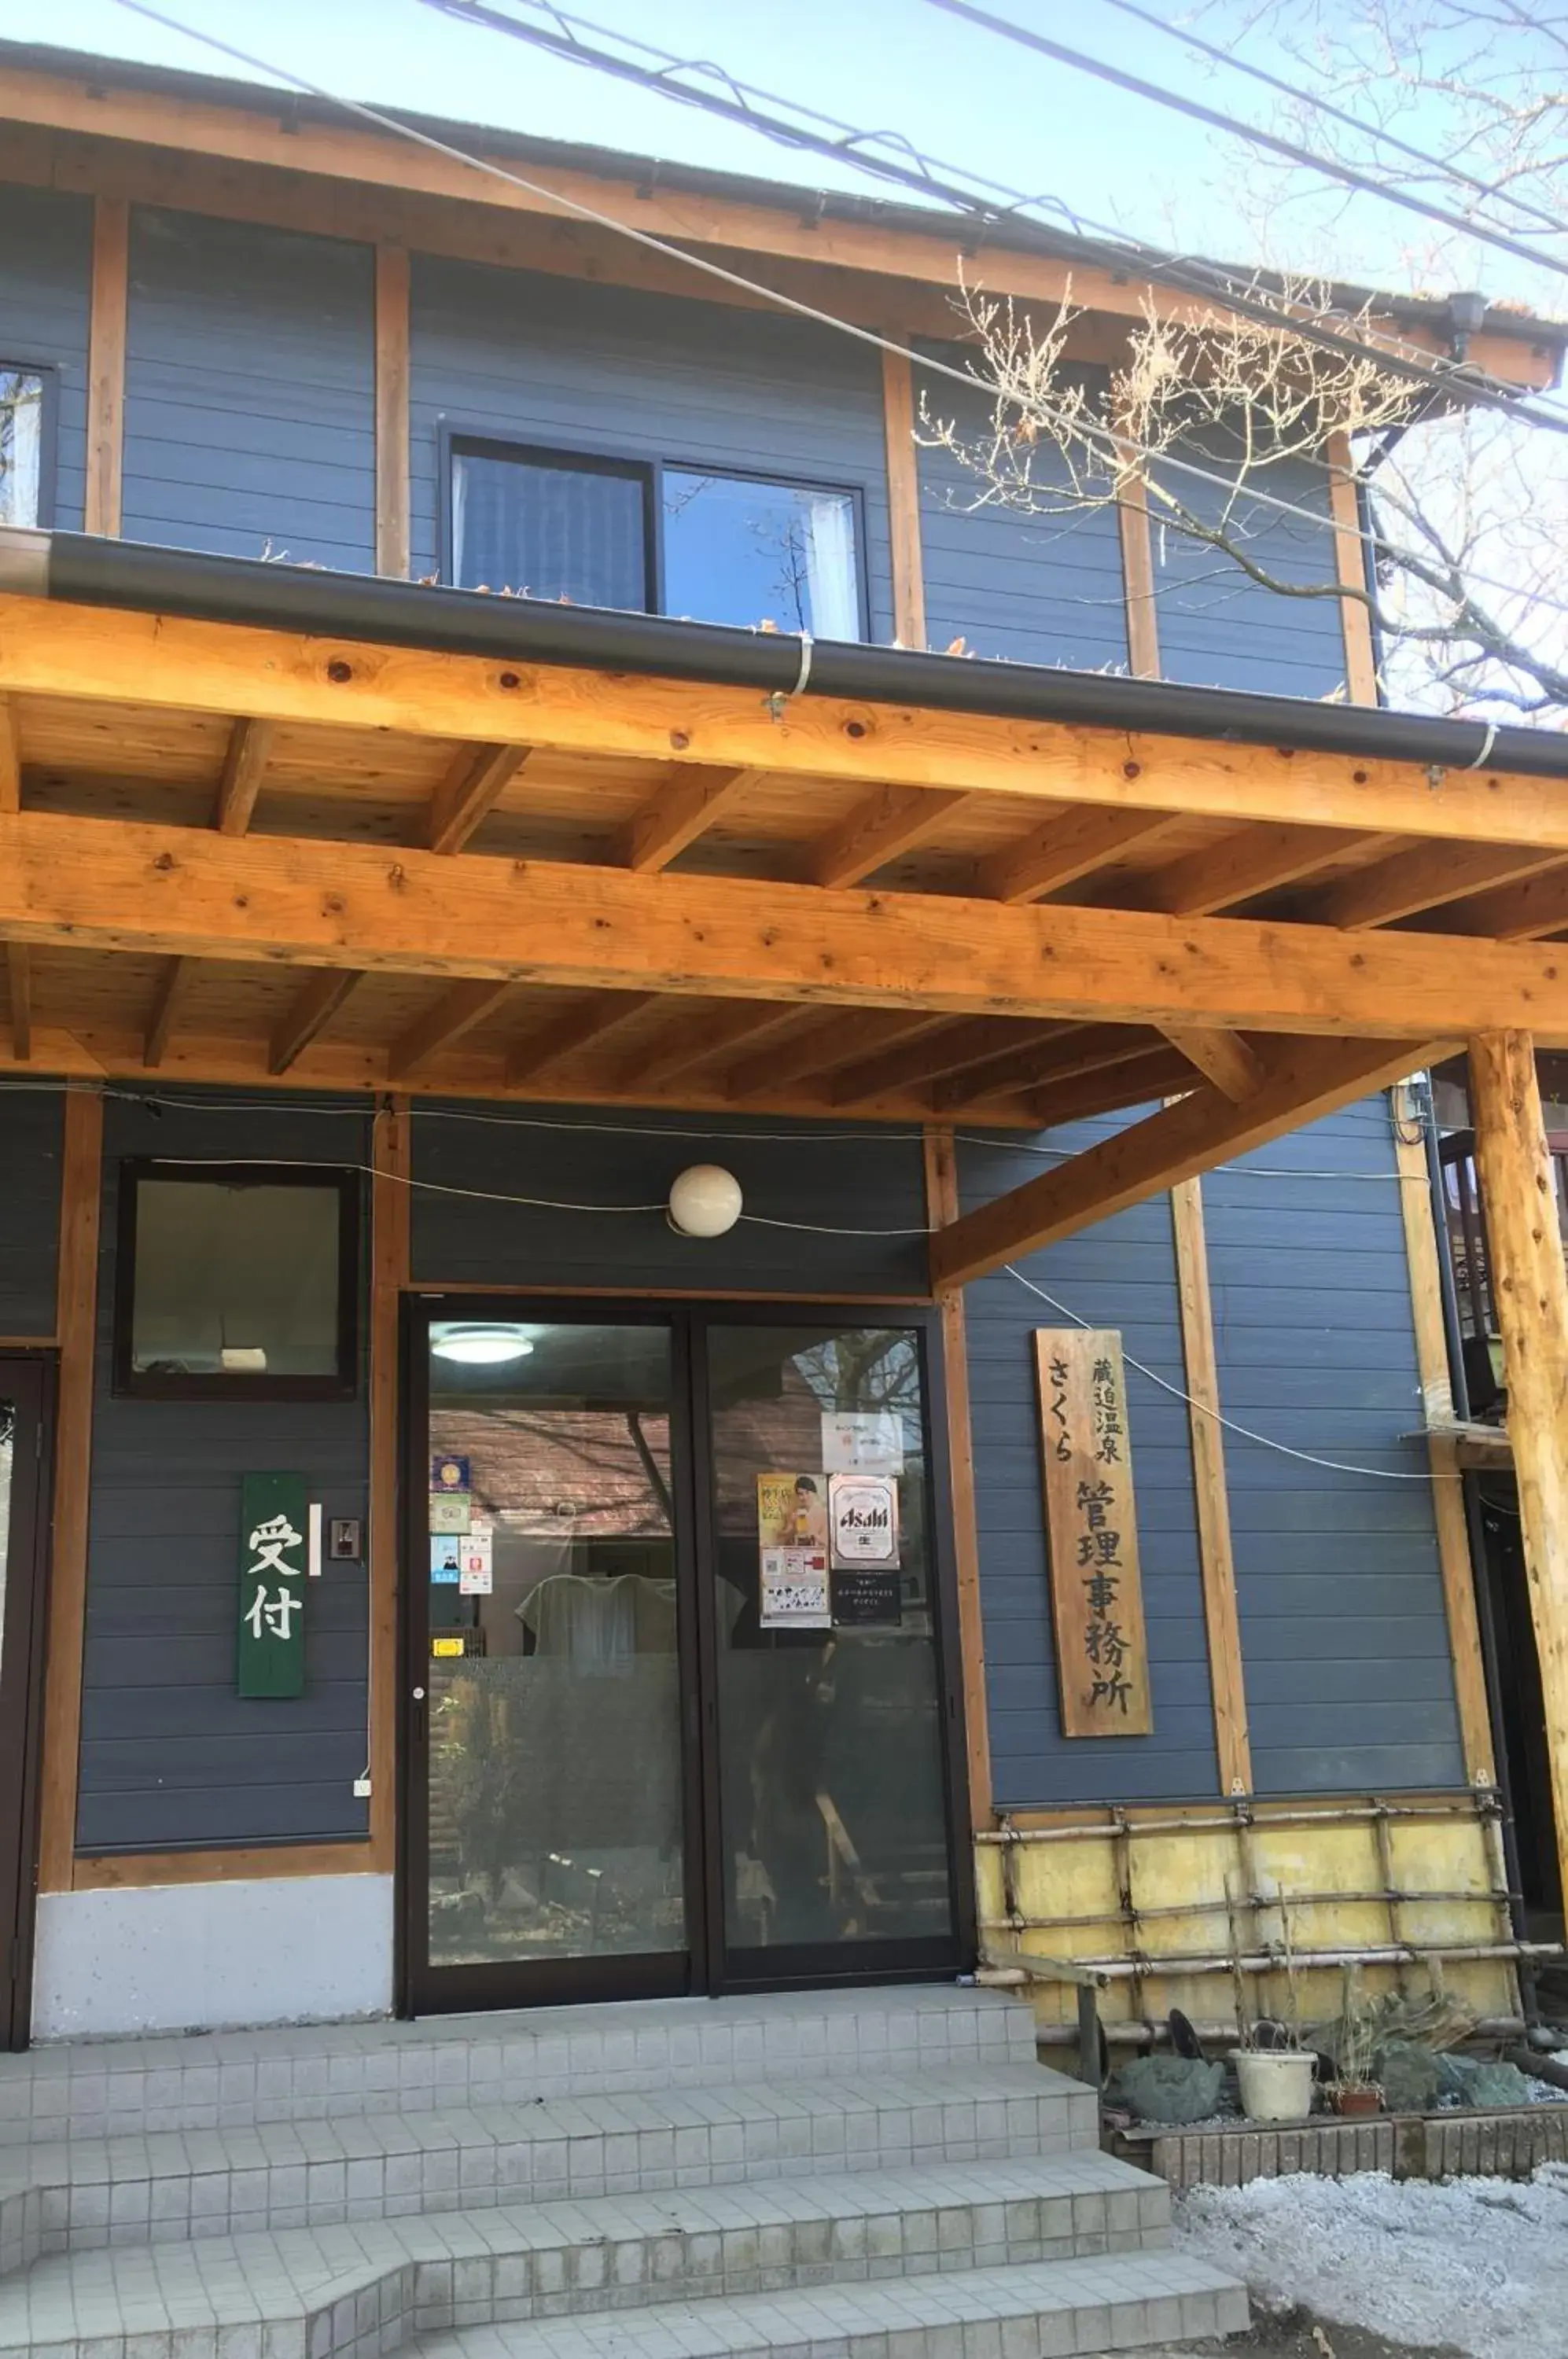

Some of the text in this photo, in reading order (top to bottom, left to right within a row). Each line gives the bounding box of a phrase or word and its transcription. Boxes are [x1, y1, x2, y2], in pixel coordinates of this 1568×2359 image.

[1048, 1358, 1072, 1463] さくら
[840, 1507, 888, 1529] Asahi
[244, 1513, 304, 1640] 受付
[1077, 1480, 1132, 1716] 管理事務所
